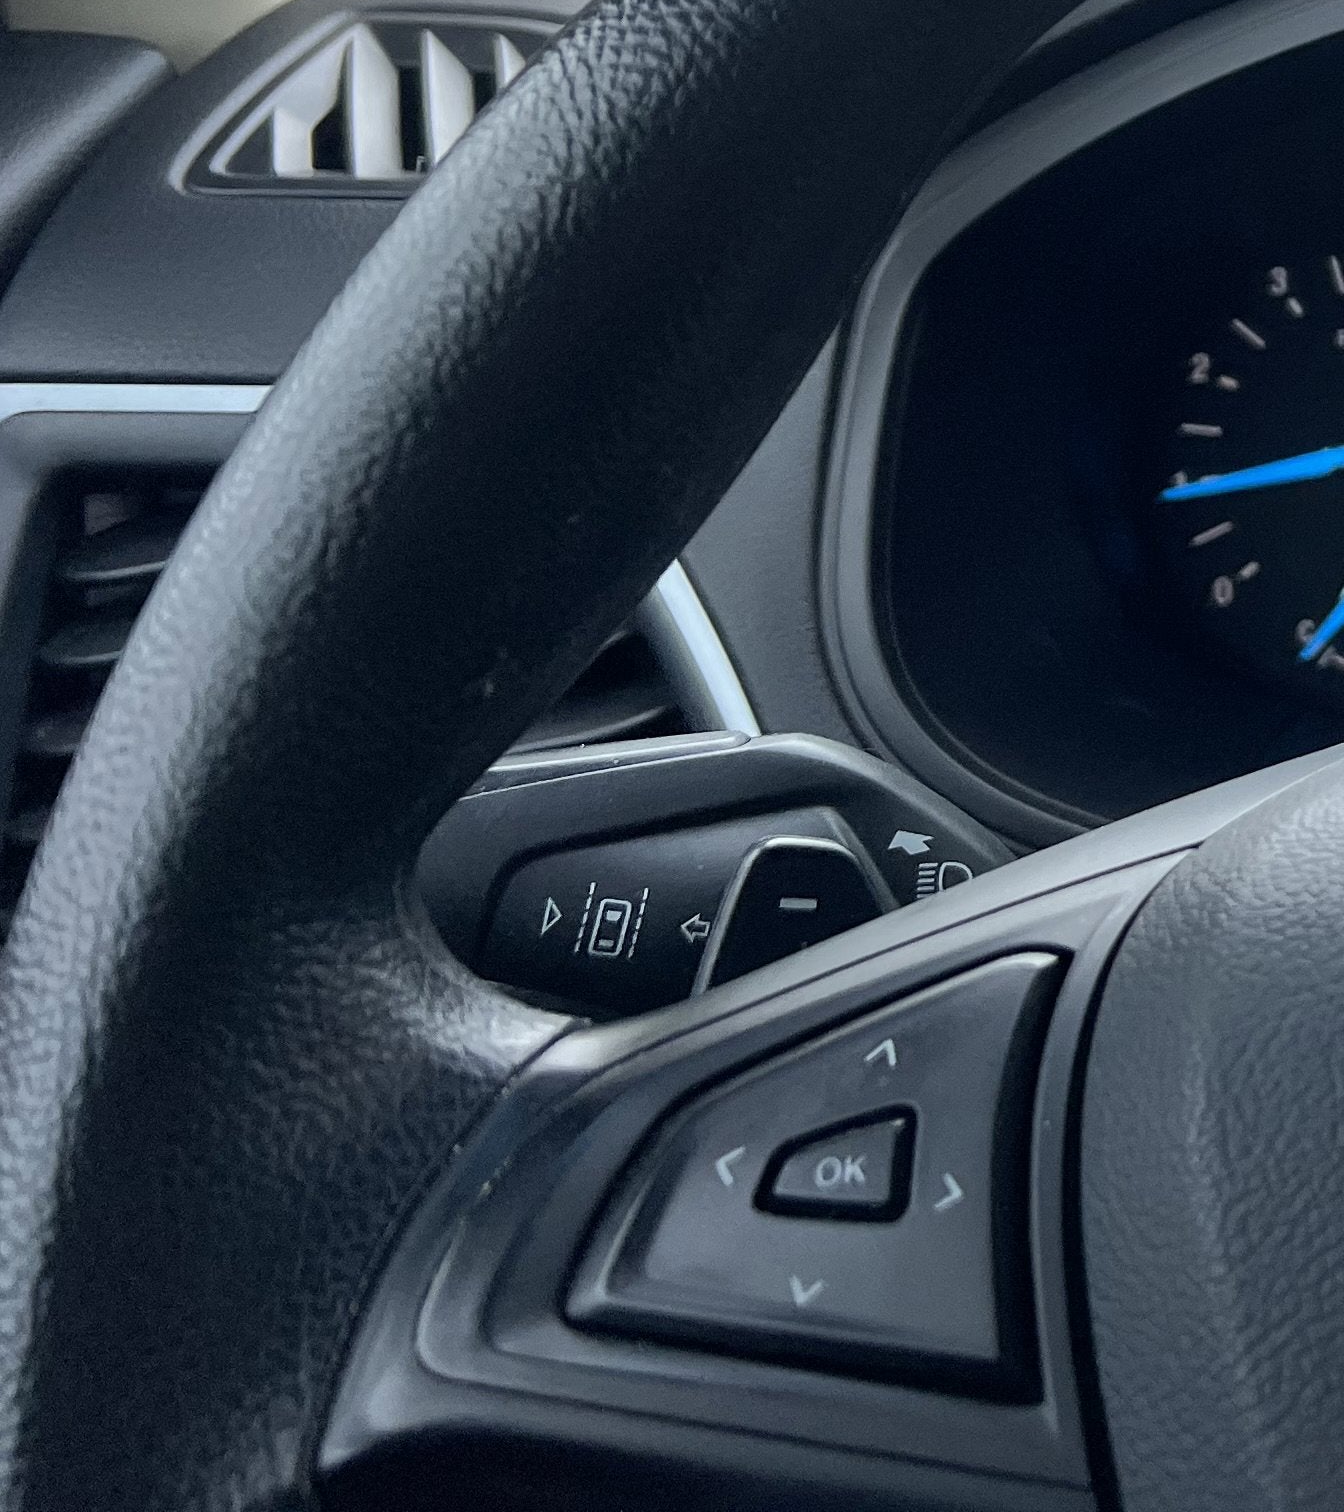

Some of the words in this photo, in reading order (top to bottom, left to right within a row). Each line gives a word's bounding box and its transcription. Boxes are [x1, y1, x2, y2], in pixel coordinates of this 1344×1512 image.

[1269, 267, 1288, 295] 3
[1190, 353, 1211, 383] 2
[1213, 574, 1234, 606] 0
[814, 1153, 867, 1189] OK
